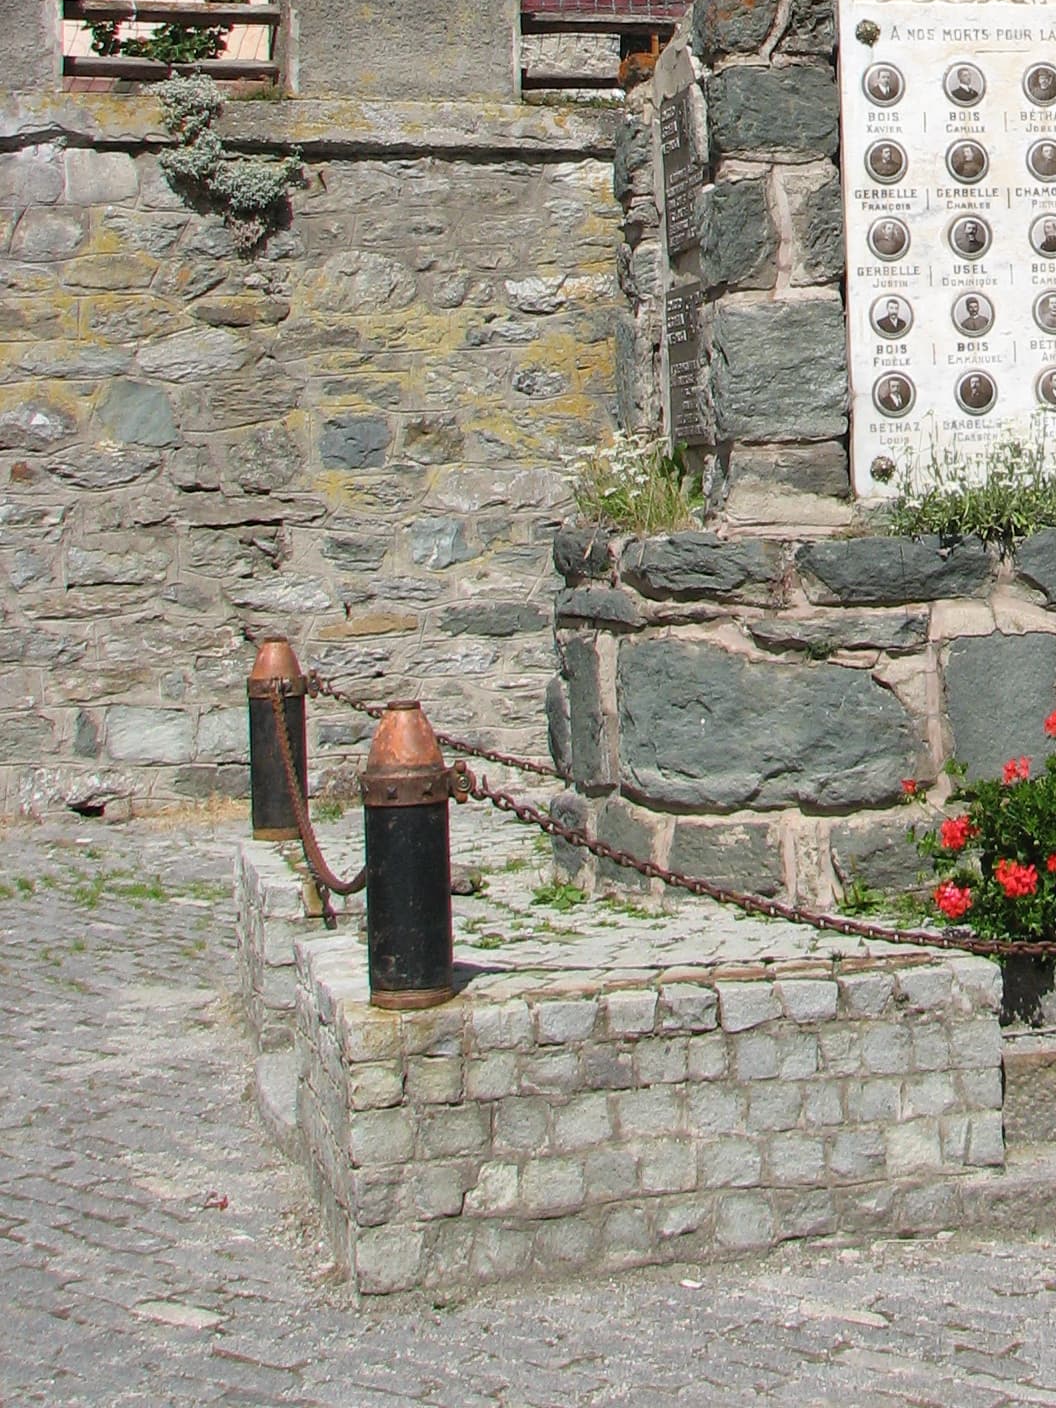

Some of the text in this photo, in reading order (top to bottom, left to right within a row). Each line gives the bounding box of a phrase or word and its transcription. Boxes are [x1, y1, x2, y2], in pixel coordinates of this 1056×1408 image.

[907, 28, 935, 41] NOS
[942, 28, 989, 41] MORTS
[996, 28, 1032, 41] POUR
[1040, 28, 1056, 41] LA
[867, 111, 900, 122] BOIS
[949, 111, 980, 122] BOIS
[854, 189, 917, 199] GERBELLE
[936, 187, 999, 198] GERBELLE
[857, 266, 921, 277] GERBELLE
[953, 265, 988, 274] USEL
[876, 344, 908, 355] BOIS
[957, 342, 989, 352] BOIS
